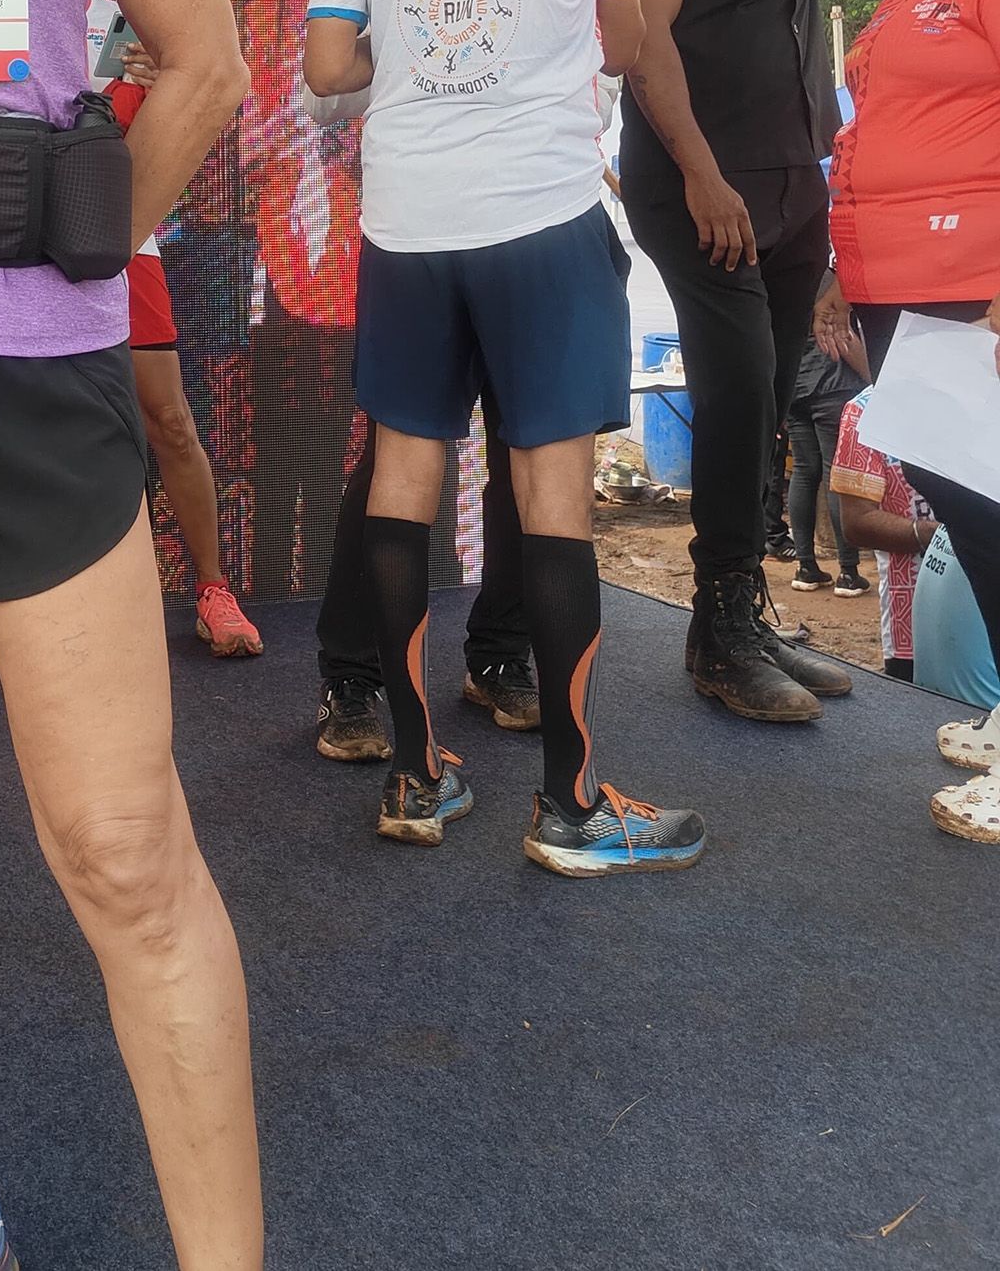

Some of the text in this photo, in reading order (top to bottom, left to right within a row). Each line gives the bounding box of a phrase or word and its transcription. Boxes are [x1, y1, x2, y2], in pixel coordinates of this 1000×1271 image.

[435, 21, 482, 46] REDISCOVER
[412, 72, 499, 95] BACK TO ROOTS
[925, 554, 947, 576] 2025
